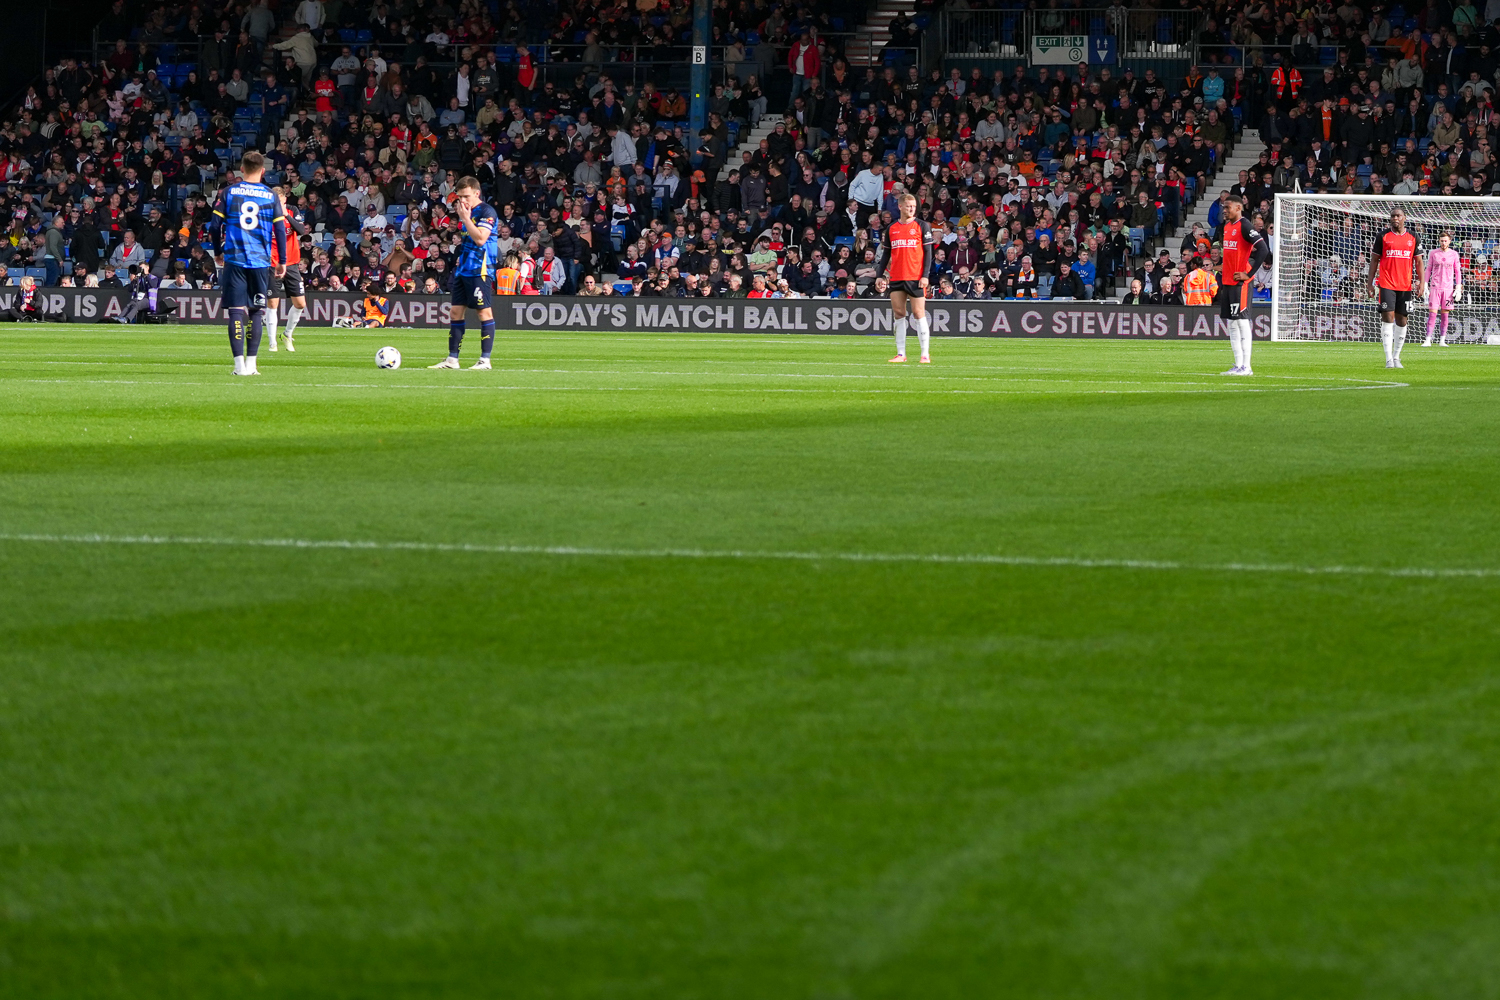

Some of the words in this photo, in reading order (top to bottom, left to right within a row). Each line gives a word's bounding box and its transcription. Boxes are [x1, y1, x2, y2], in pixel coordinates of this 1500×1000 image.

[1039, 38, 1057, 46] EXIT
[696, 52, 702, 63] B
[1072, 49, 1079, 60] 3
[230, 187, 273, 200] BROADBENT
[240, 201, 259, 231] 8
[473, 286, 483, 300] 4
[74, 294, 97, 318] IS
[104, 295, 122, 318] A
[279, 297, 452, 325] LANDSAPES
[1405, 300, 1414, 313] 15
[512, 301, 627, 328] TODAY'S
[635, 303, 734, 330] MATCH
[743, 304, 808, 331] BALL
[959, 310, 984, 333] IS
[991, 310, 1013, 334] A
[1020, 310, 1044, 335] C
[1051, 311, 1169, 337] STEVENS
